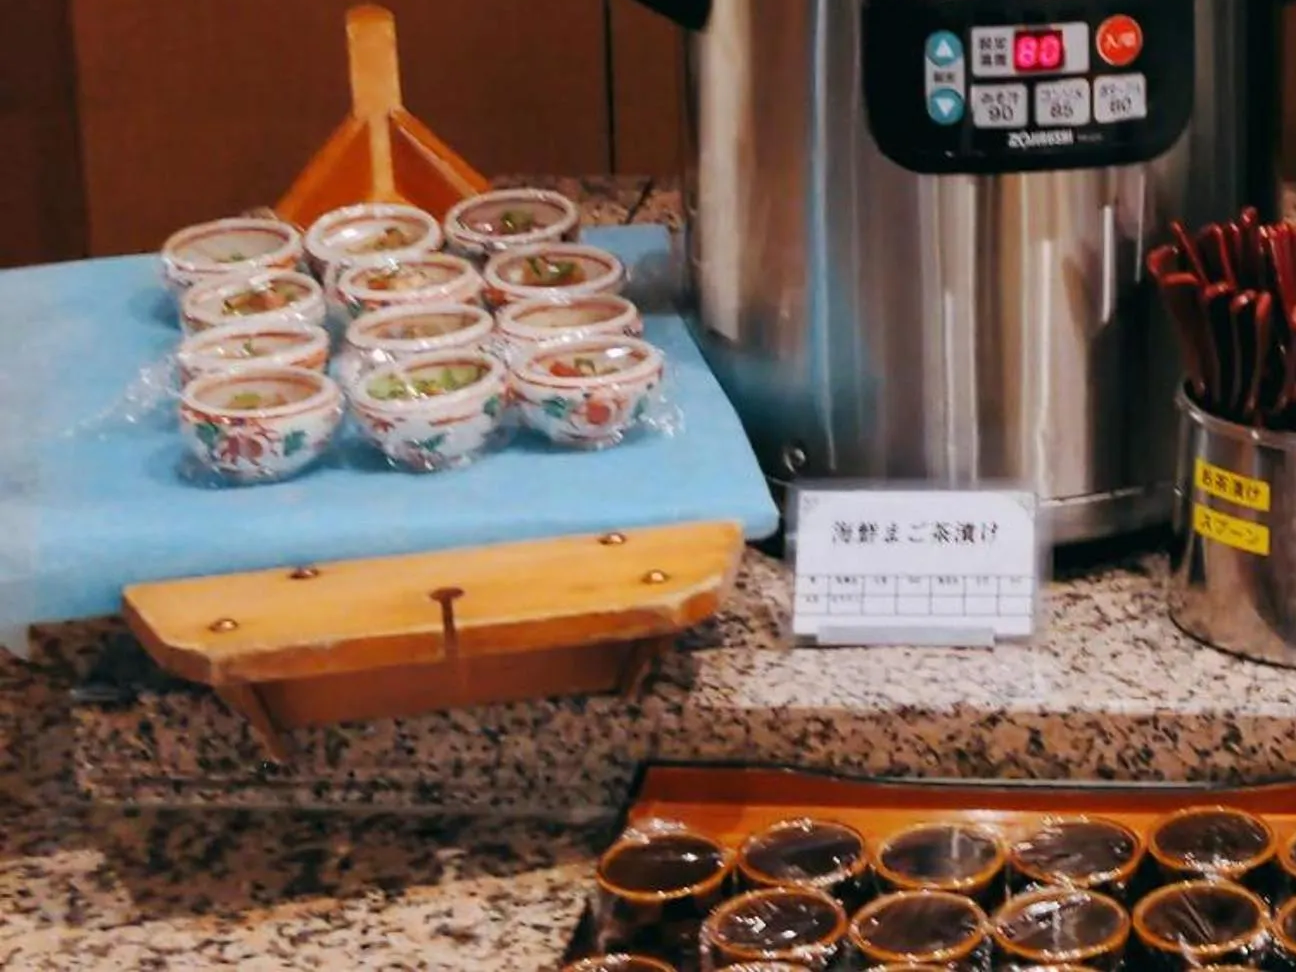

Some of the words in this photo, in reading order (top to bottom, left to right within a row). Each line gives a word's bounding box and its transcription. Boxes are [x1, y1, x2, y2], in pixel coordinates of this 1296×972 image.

[832, 521, 998, 544] 海鮮まご茶漬け
